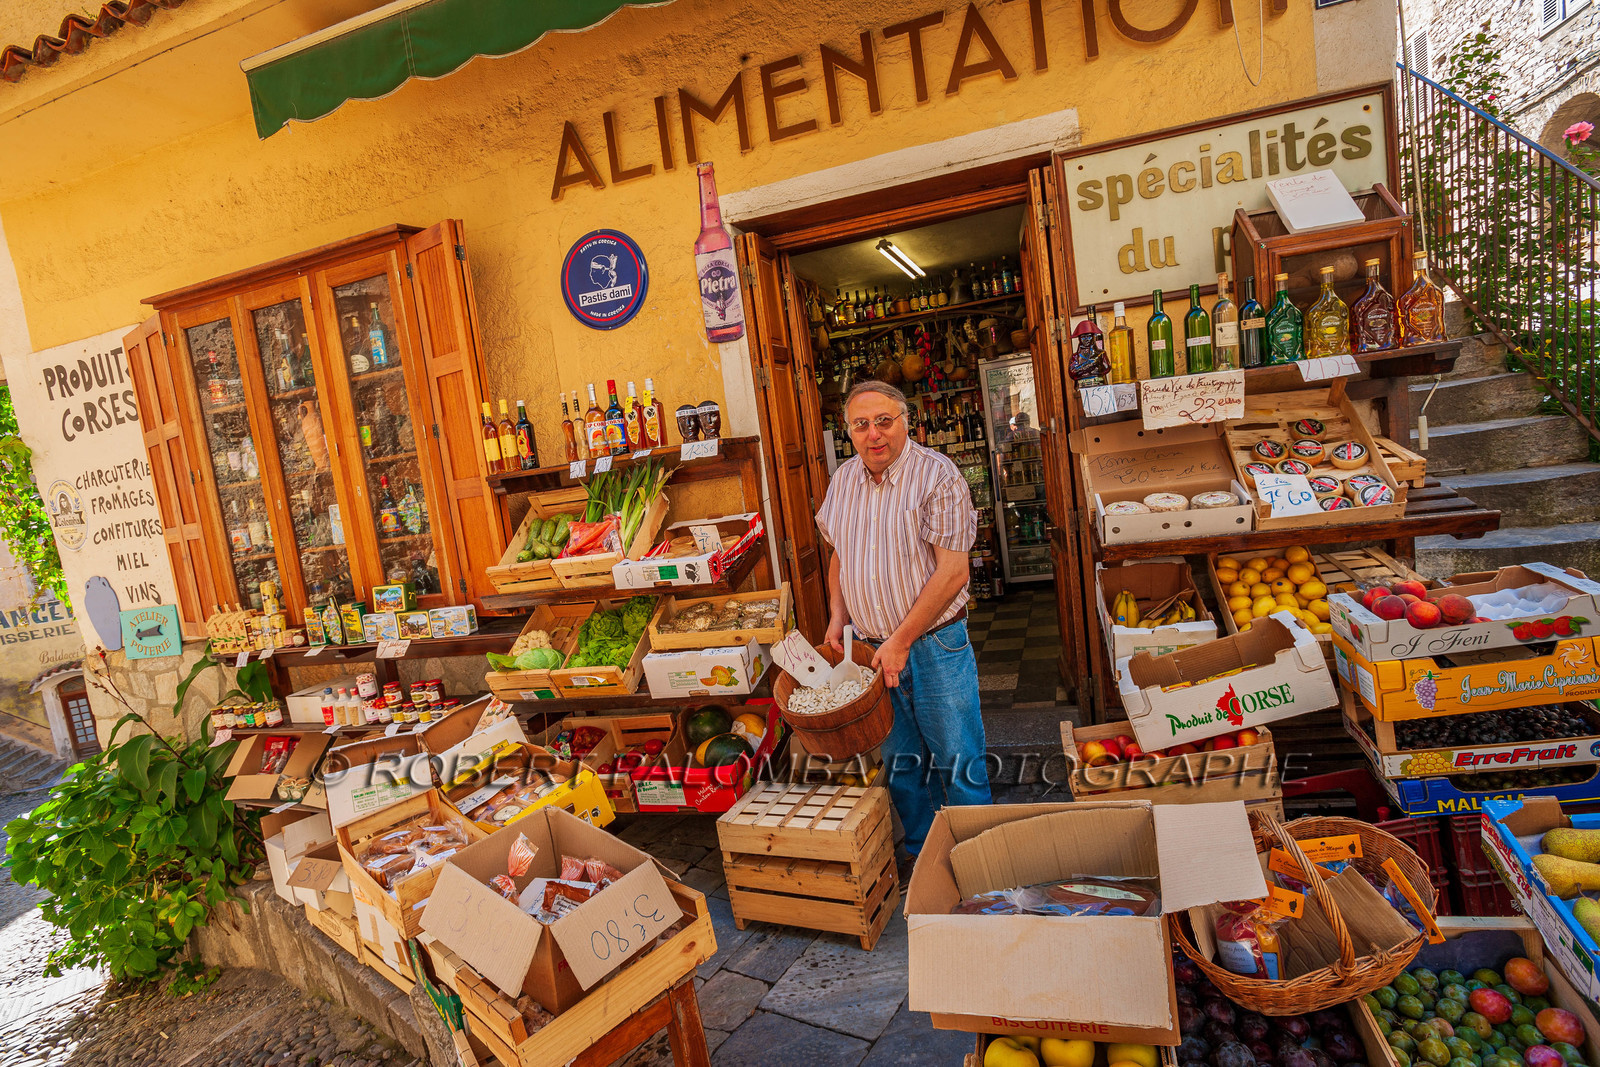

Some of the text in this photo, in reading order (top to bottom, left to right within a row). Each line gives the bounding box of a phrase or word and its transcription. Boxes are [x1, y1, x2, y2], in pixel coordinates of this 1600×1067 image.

[551, 0, 1288, 200] ALIMENTATIO
[1076, 116, 1373, 221] spécialités
[1117, 227, 1180, 275] du
[580, 285, 631, 305] Pastis dami
[701, 275, 737, 295] Pietra
[42, 347, 131, 401] PRODUIT
[75, 458, 151, 490] CHARCUTERIE
[91, 489, 155, 514] FROMAGES
[93, 518, 163, 545] CONFITURES
[117, 553, 149, 571] MIEL
[125, 582, 161, 605] VINS
[130, 611, 169, 631] ATELIER
[131, 637, 171, 656] POTERIE
[1460, 670, 1545, 704] Jean-Marie
[1165, 683, 1295, 737] Produit de CORSE
[992, 1016, 1110, 1035] BISCUITERIE
